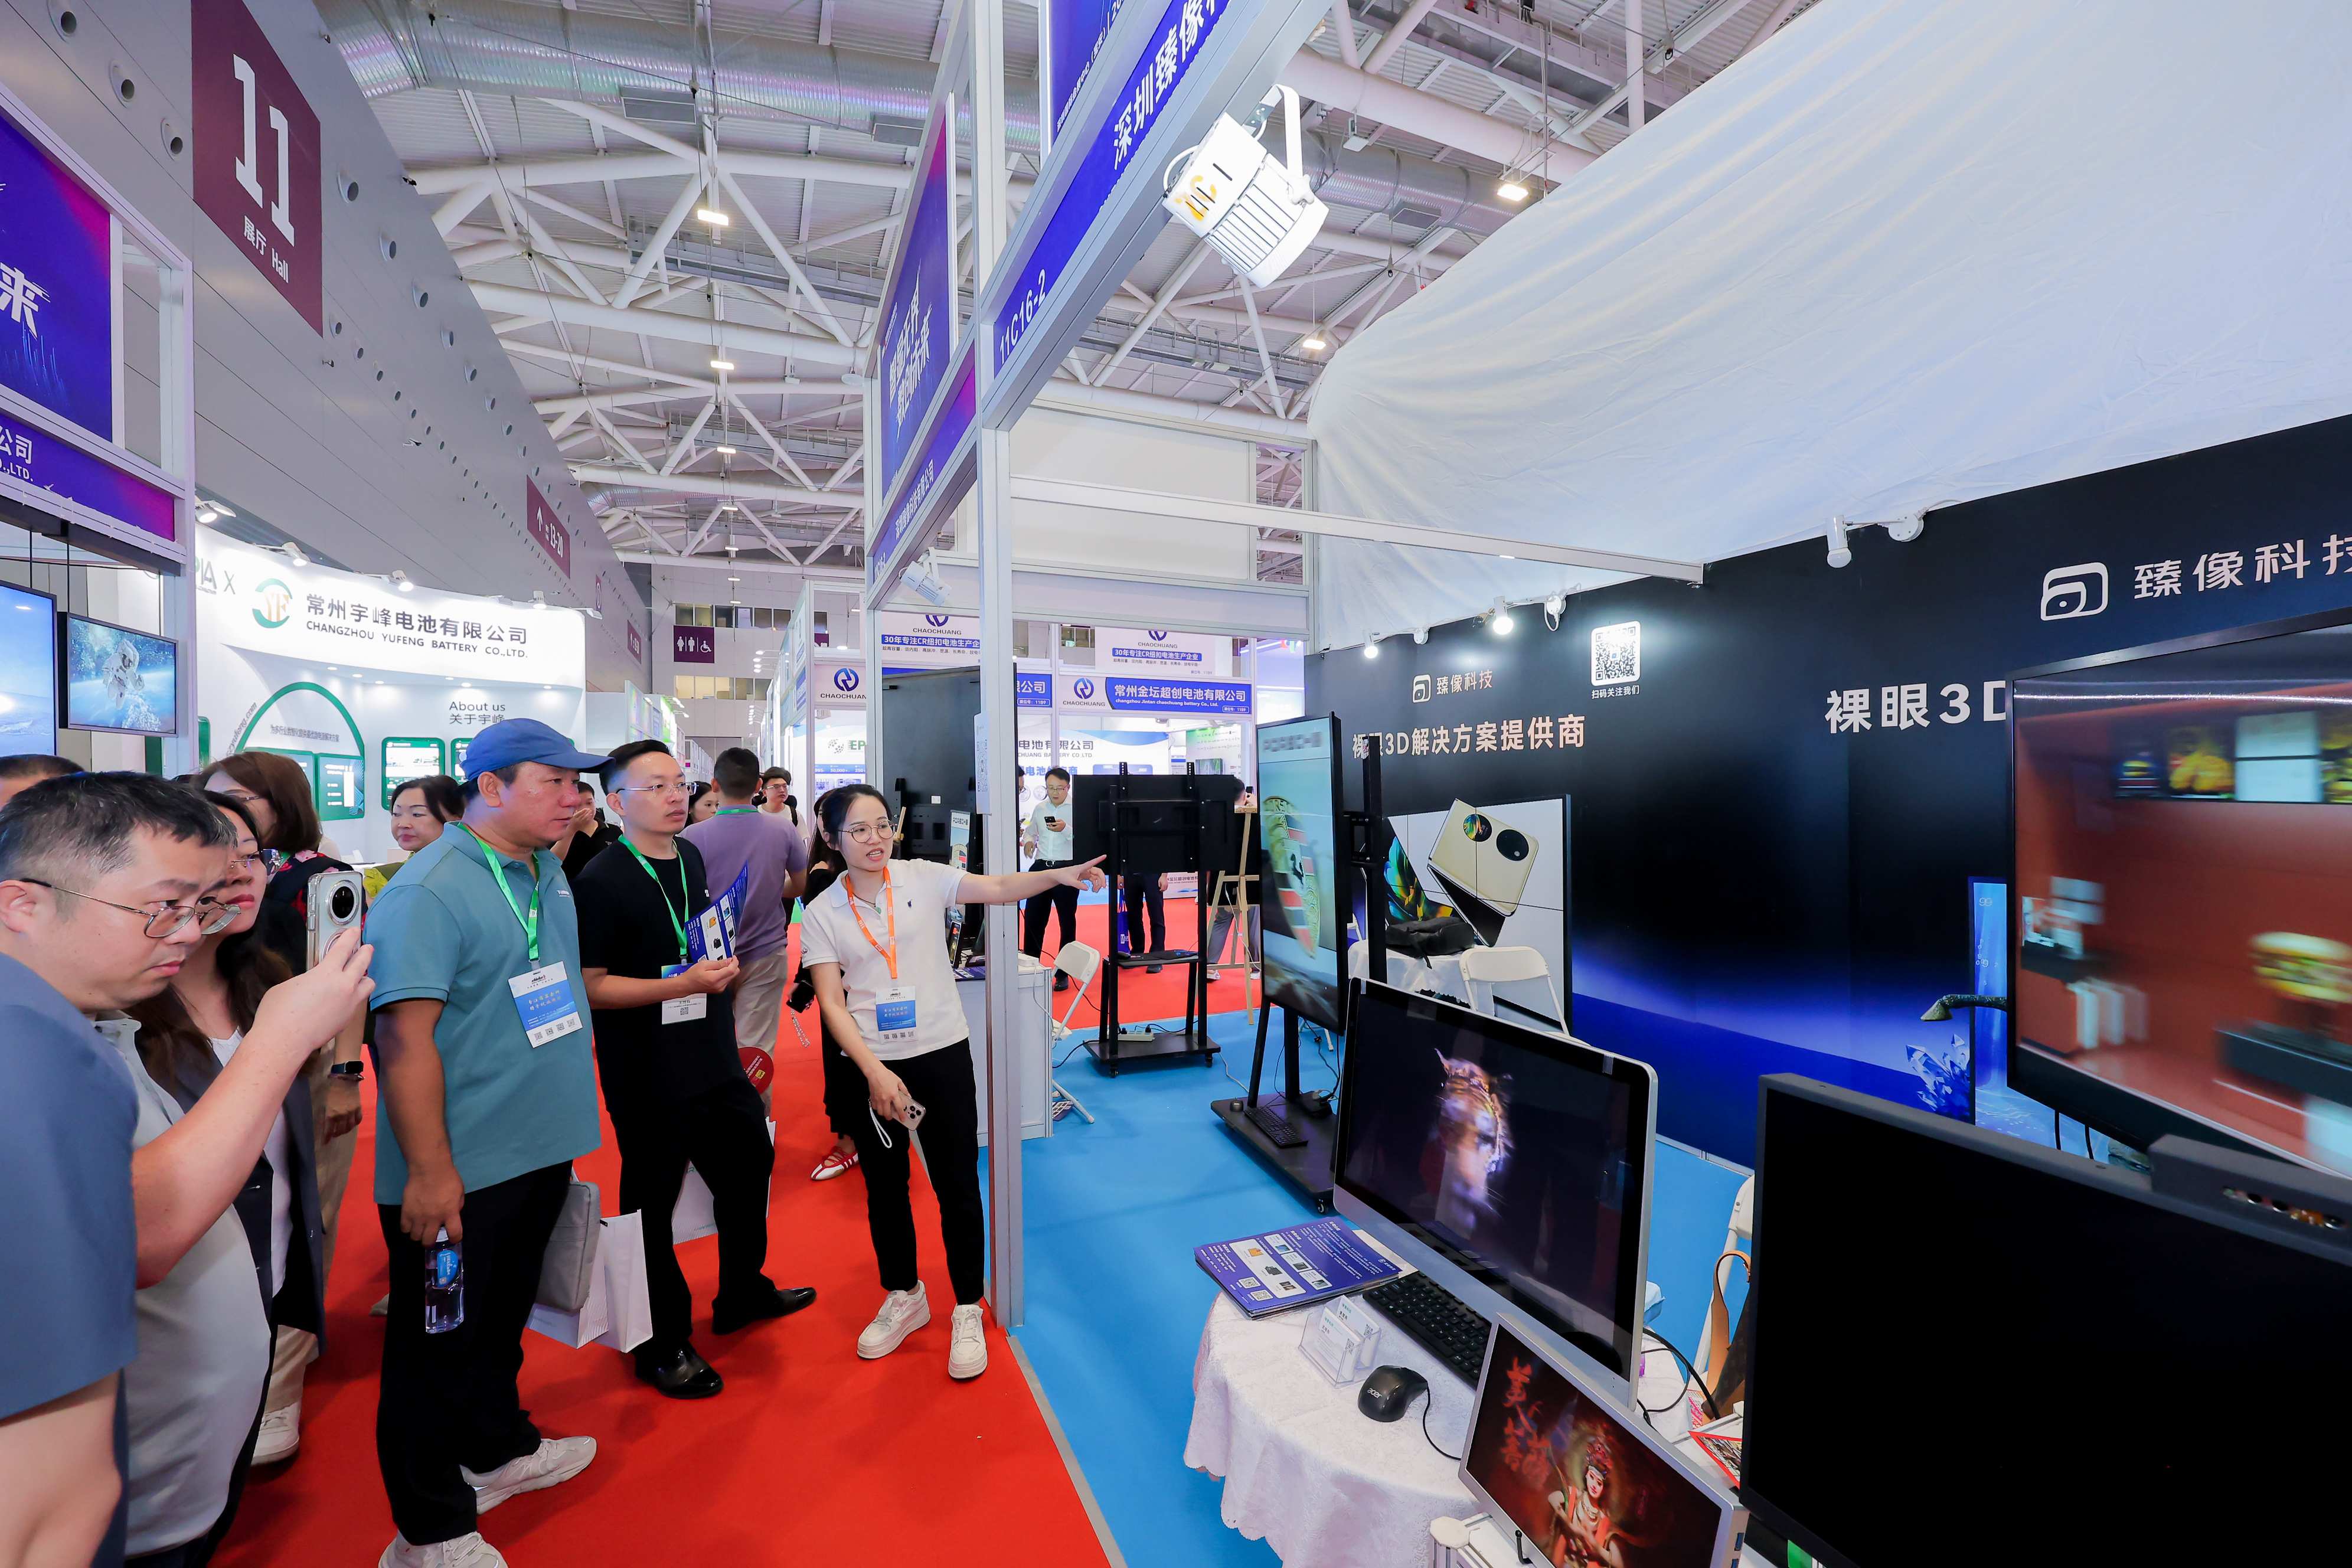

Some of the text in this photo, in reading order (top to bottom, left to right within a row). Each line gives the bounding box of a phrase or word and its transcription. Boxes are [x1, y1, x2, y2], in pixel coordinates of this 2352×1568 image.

[233, 53, 295, 247] 11
[243, 215, 289, 283] 展厅 Hall
[999, 268, 1046, 365] 11C16-2
[890, 266, 920, 408] 智显无界
[0, 425, 32, 465] 公司
[2134, 533, 2352, 599] 臻像科技
[306, 593, 527, 645] 常州宇峰电池有限公司
[306, 620, 528, 658] CHANGZHOU YUFENG BATTERY CO.,LTD.
[1114, 684, 1246, 702] 常州金坛超创电池有限公司
[1436, 669, 1494, 696] 臻像科技
[1591, 684, 1641, 700] 扫码关注我们
[449, 701, 506, 712] About us
[449, 714, 505, 725] 关于宇峰
[1367, 1387, 1383, 1399] acer
